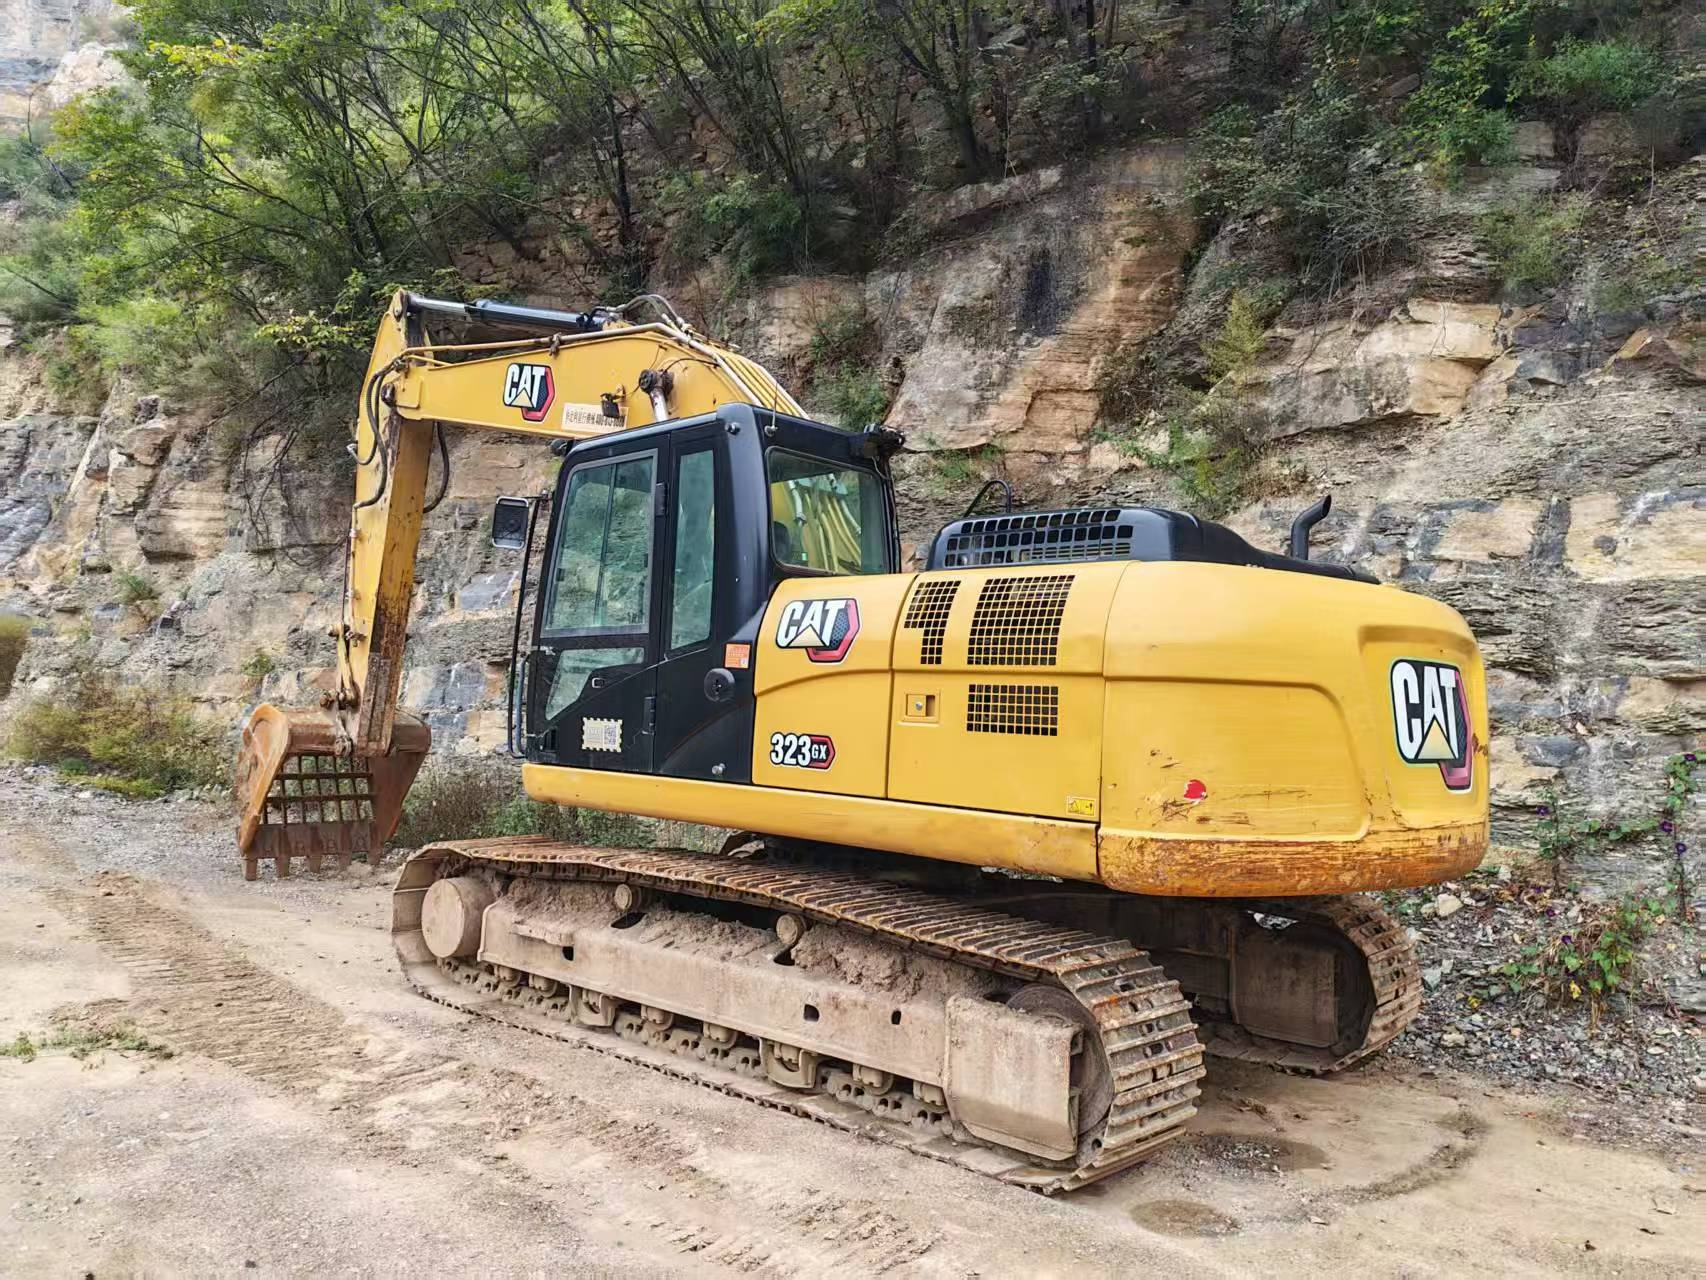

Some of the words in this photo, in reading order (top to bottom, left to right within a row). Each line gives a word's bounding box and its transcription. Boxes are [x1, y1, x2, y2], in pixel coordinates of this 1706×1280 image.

[504, 363, 546, 408] CAT
[776, 600, 847, 647] CAT
[1392, 661, 1459, 760] CAT
